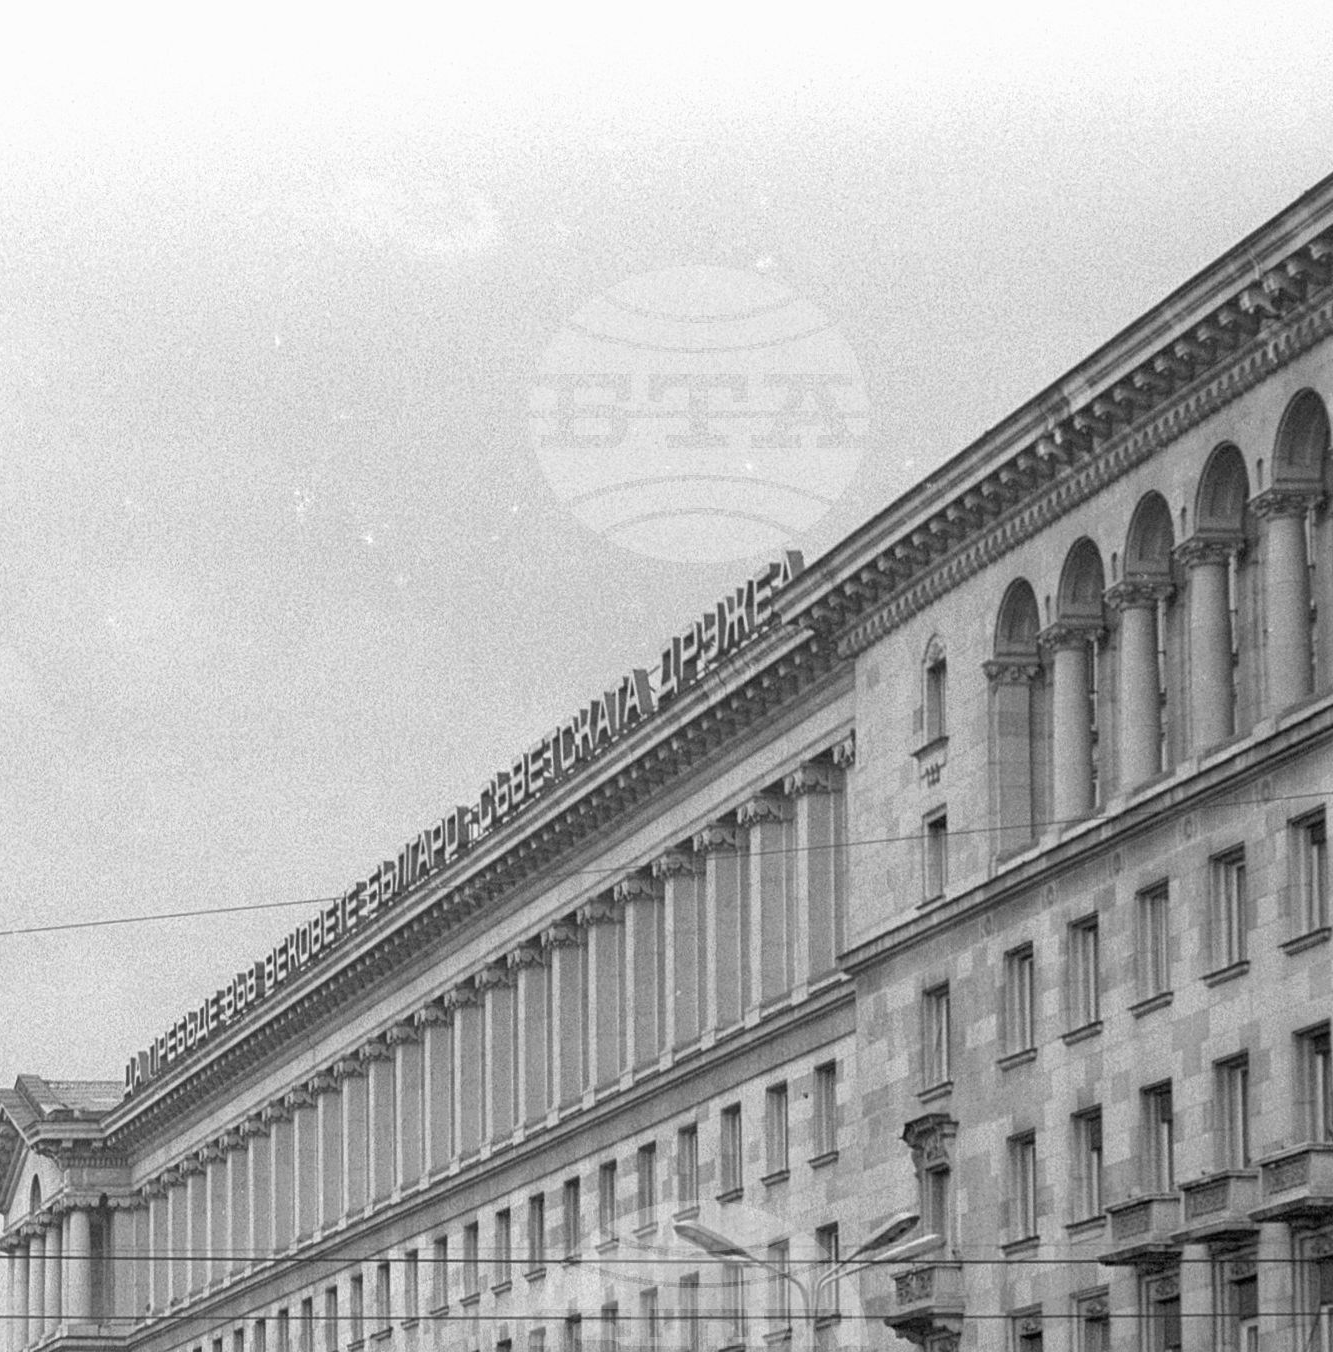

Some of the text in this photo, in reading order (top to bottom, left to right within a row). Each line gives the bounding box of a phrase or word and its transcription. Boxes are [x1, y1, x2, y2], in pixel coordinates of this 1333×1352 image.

[123, 1055, 142, 1097] ДА
[148, 996, 218, 1075] ПРЕБЪДЕ
[225, 966, 256, 1018] ВЪВ
[264, 889, 358, 990] ВЕКОВЕТЕ
